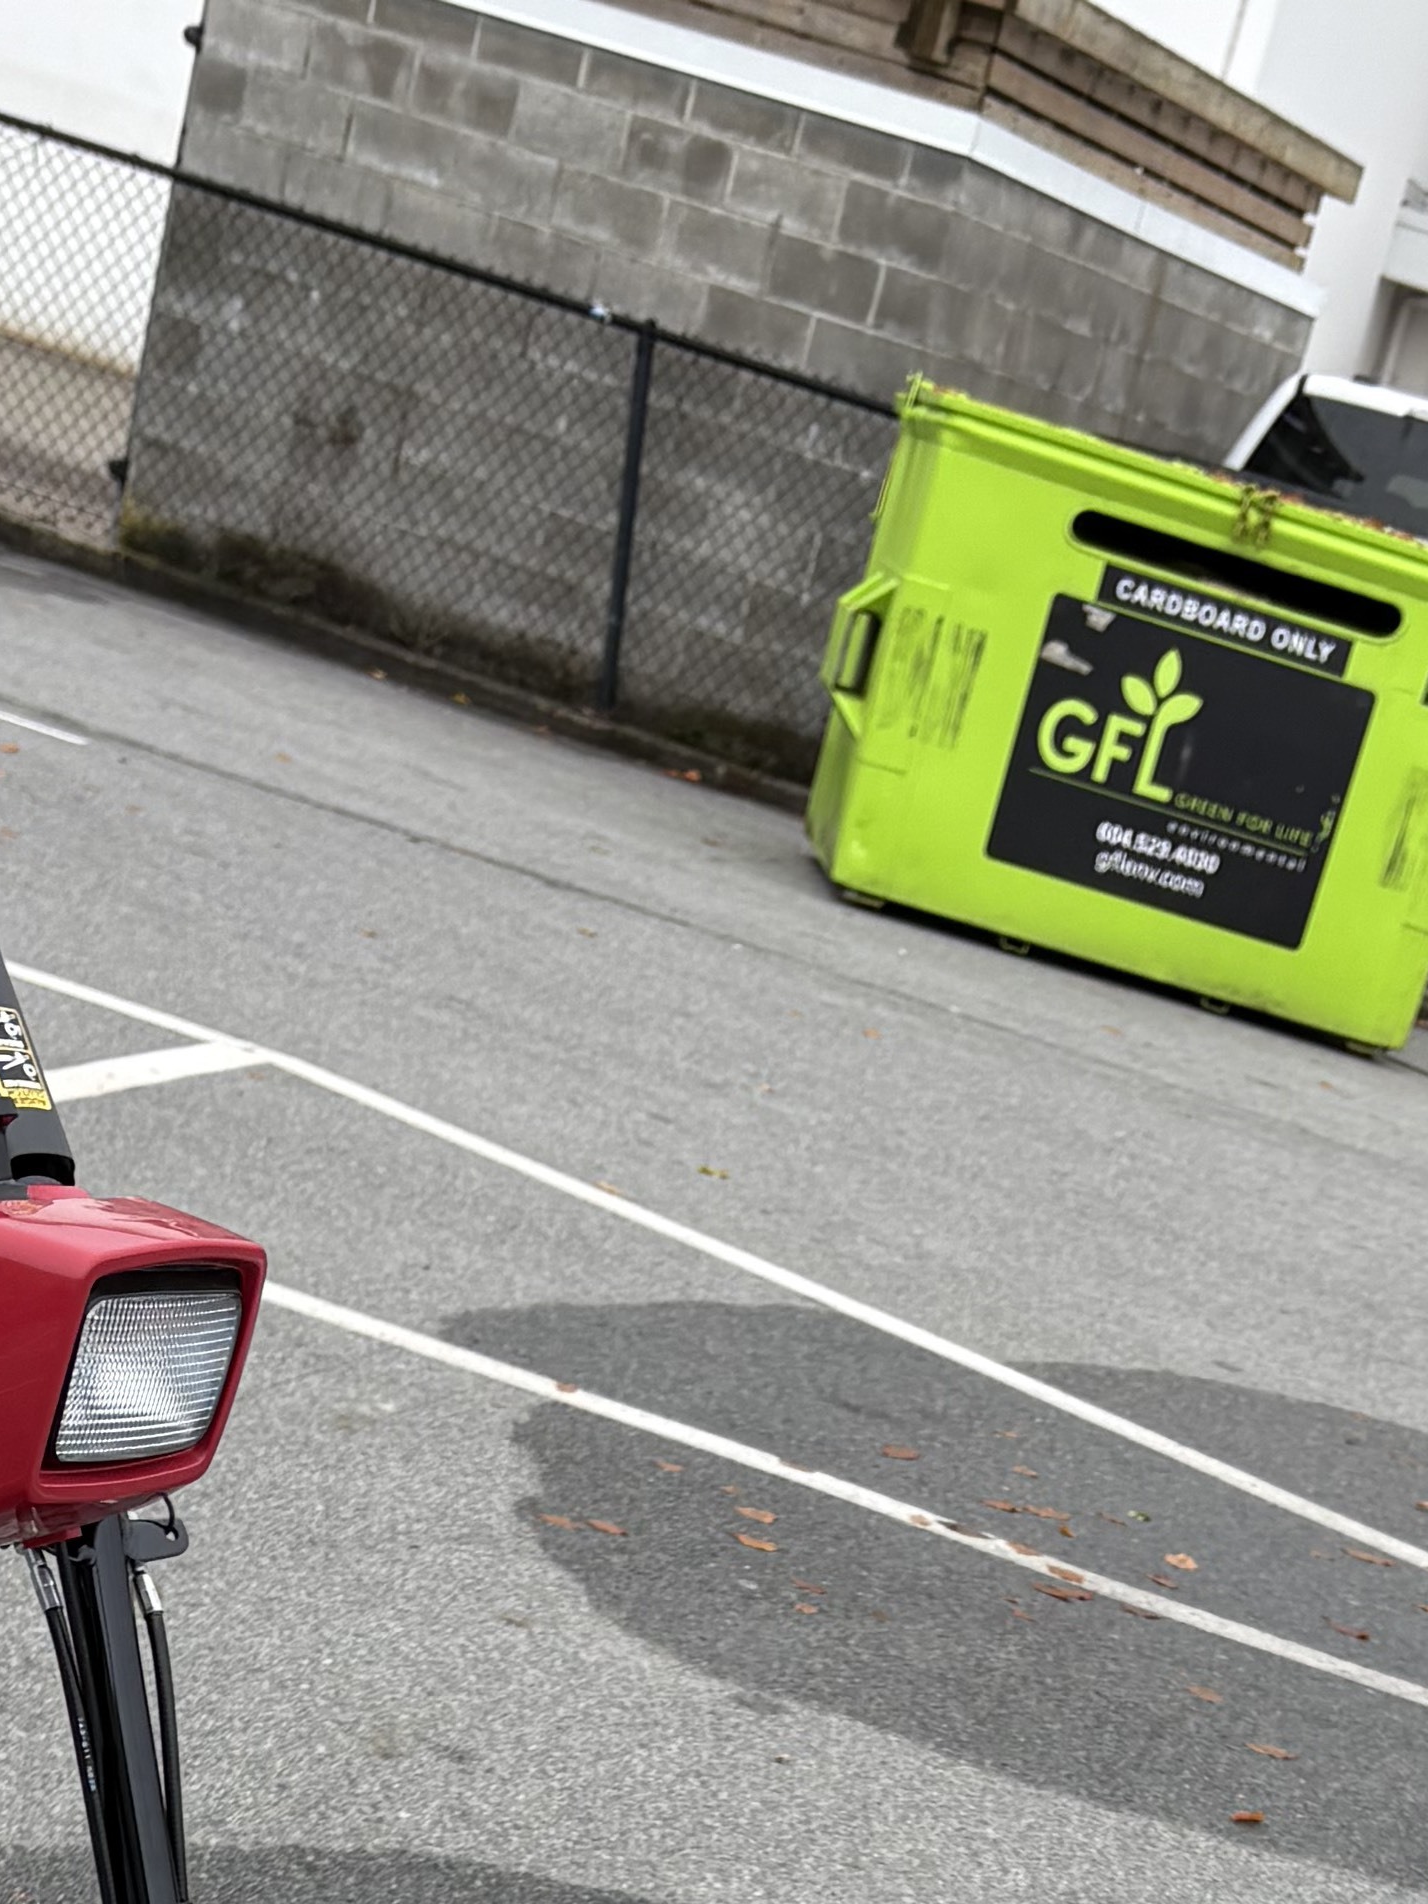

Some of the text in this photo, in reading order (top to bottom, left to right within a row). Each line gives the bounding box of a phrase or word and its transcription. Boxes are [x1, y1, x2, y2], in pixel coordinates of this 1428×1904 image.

[1115, 579, 1337, 664] CARDBOARD ONLY
[1037, 694, 1203, 802] GFL
[1174, 793, 1314, 847] GREEN FOR LIFE
